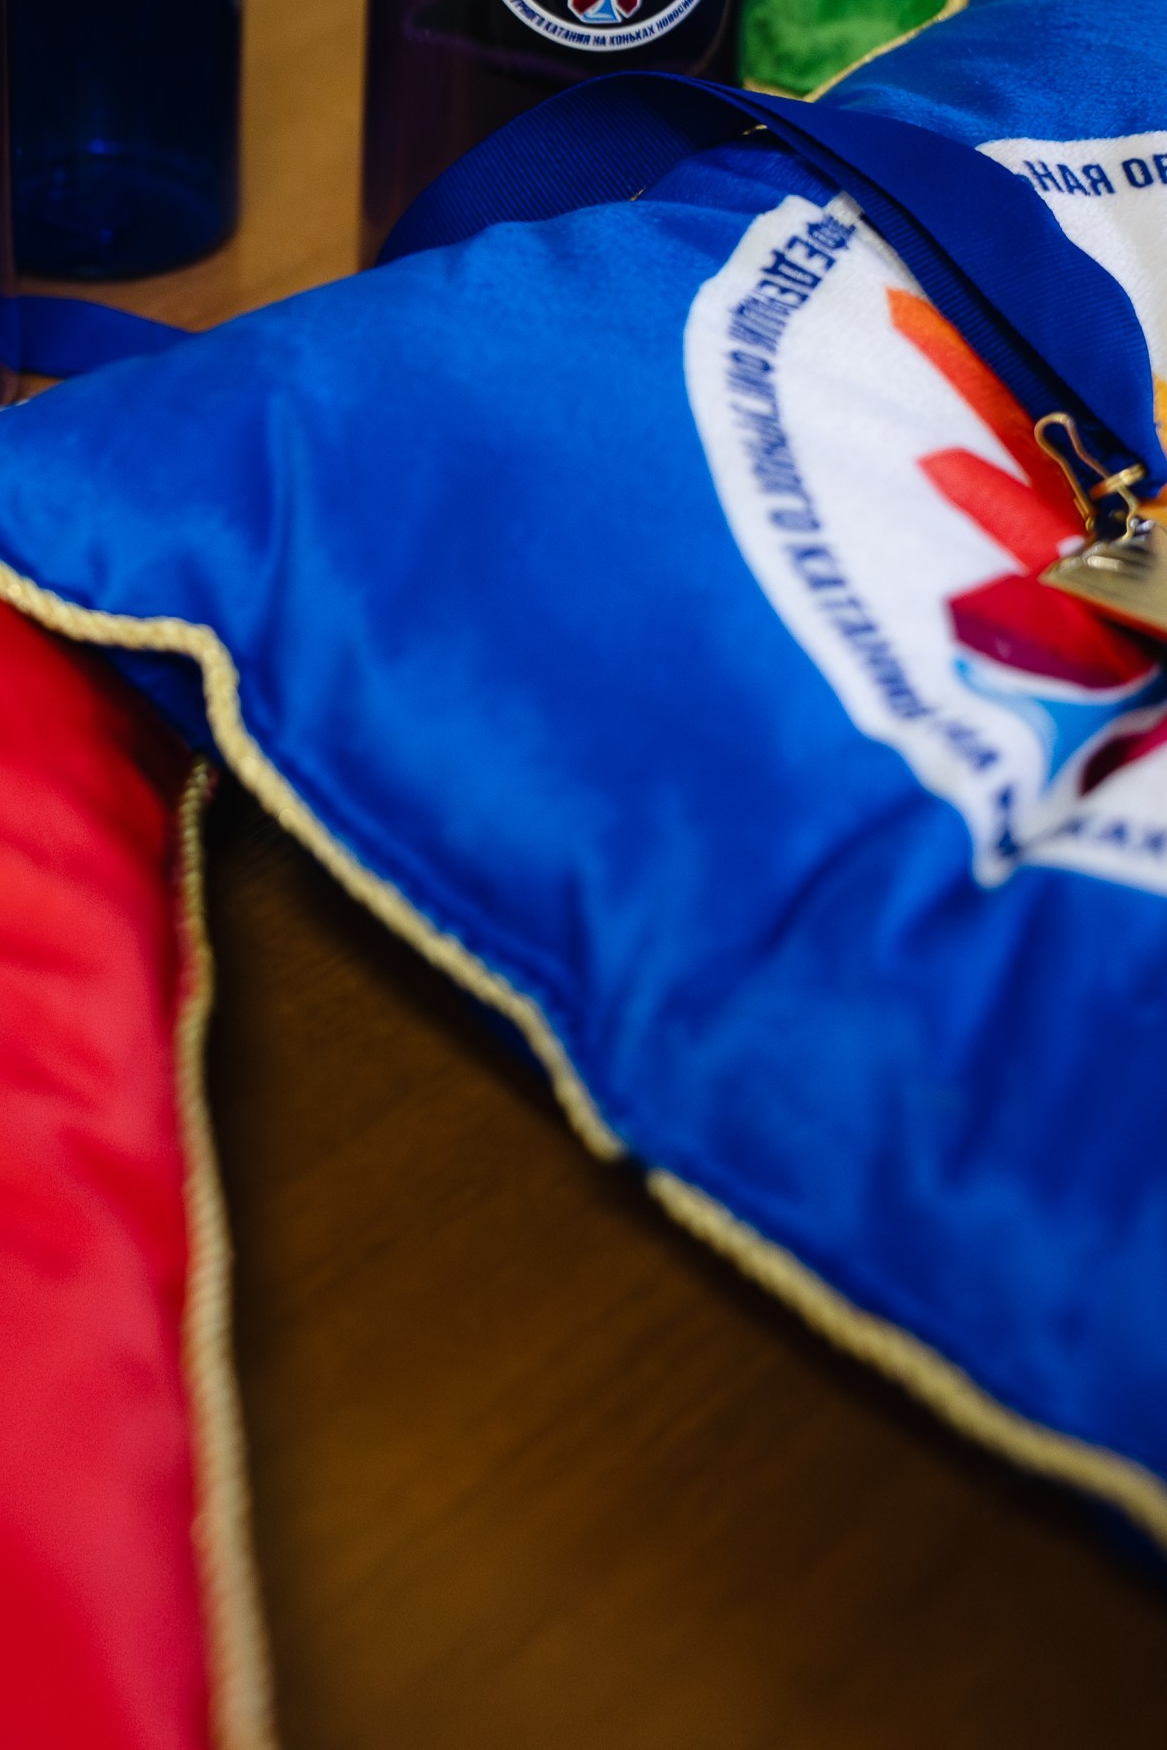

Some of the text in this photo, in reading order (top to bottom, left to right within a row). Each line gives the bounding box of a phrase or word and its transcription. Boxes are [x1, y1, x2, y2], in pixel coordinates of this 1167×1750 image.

[544, 21, 591, 46] КАТАНИЯ
[593, 34, 607, 47] НА
[608, 28, 656, 47] КОНЬКАХ
